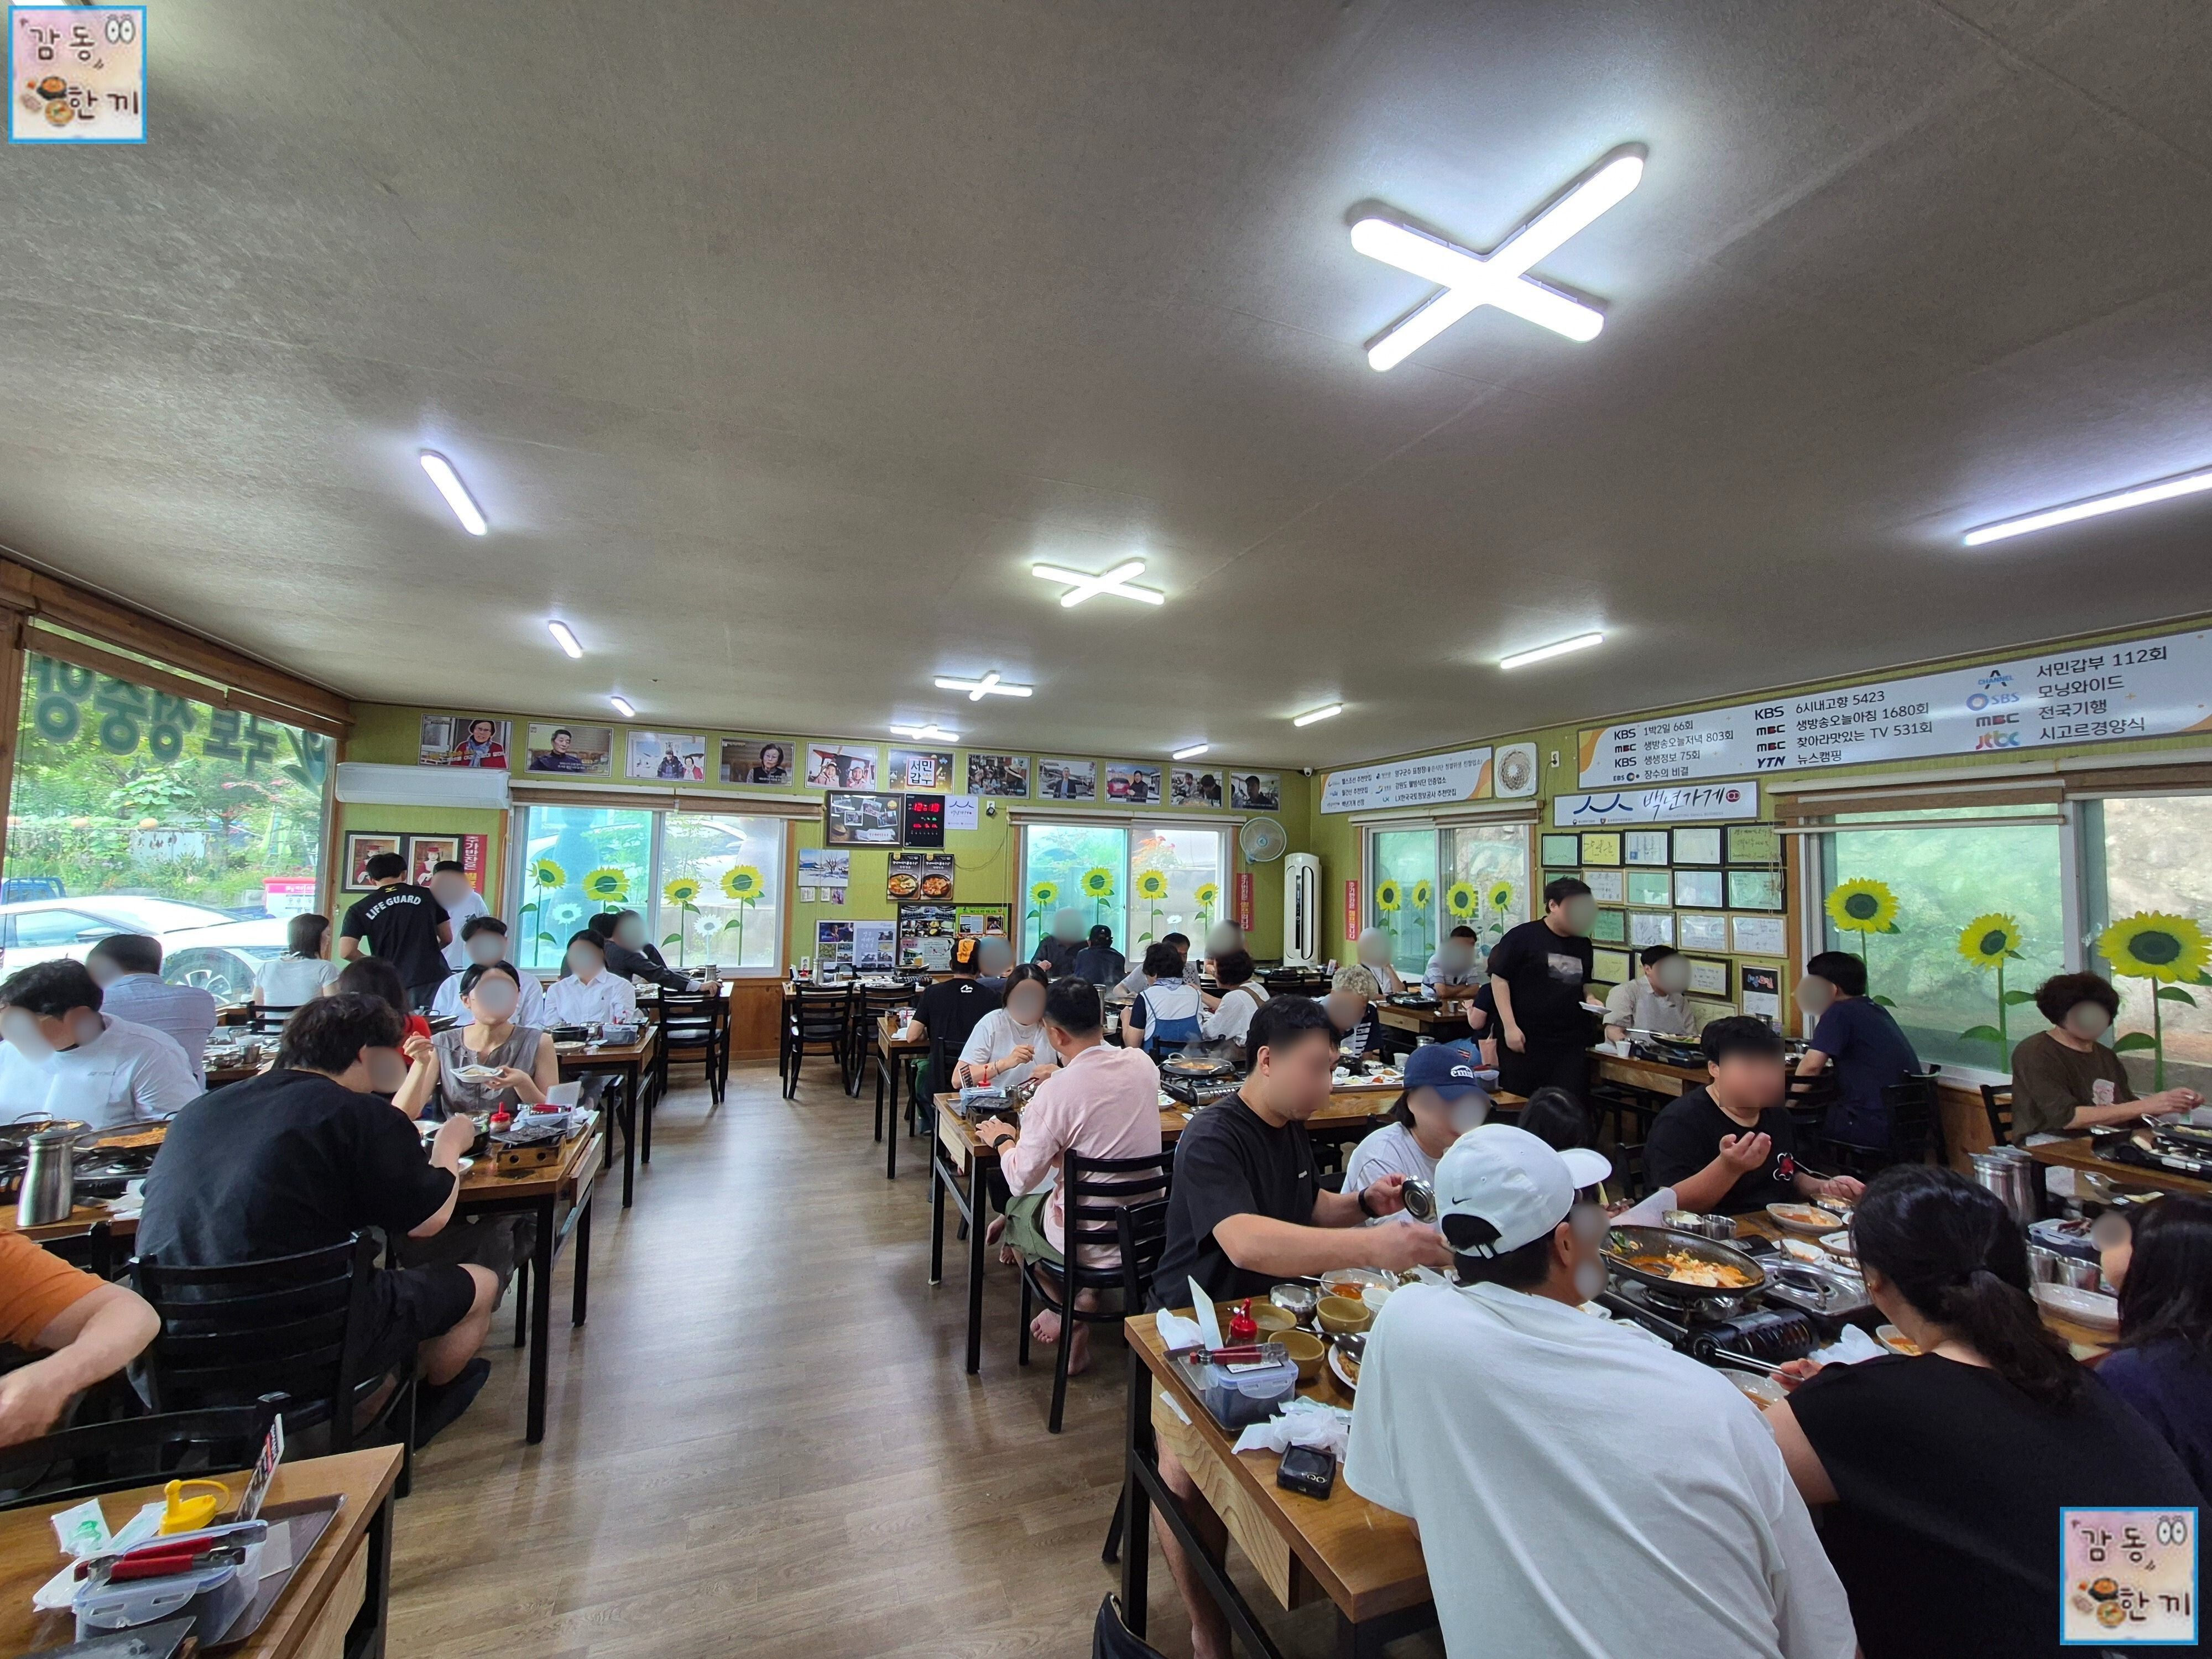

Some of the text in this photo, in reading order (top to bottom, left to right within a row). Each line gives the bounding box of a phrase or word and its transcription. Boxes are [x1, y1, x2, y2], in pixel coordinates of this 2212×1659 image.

[2037, 646, 2168, 678] 서민갑부 112회
[2038, 675, 2125, 699] 모닝와이드
[1796, 691, 1885, 714] 6시내고향 5423
[1991, 692, 2020, 705] SBS
[1755, 706, 1785, 720] KBS
[1796, 702, 1929, 731] 생방송오늘아침 1680회
[2038, 699, 2107, 720] 전국기행
[1614, 728, 1636, 740] KBS
[1644, 720, 1693, 735] 1박2일 66회
[1797, 721, 1933, 748] 찾아라맛있는 TV 531회
[2039, 717, 2146, 740] 시고르경양식
[1644, 730, 1734, 750] 생방송오늘저녁 803회
[1615, 757, 1637, 768] KBS
[1644, 750, 1700, 765] 생생정보 75회
[1757, 756, 1786, 769] YTN
[1797, 750, 1842, 765] 뉴스캠핑
[910, 760, 932, 772] 서민
[1644, 766, 1689, 780] 장수의 비결
[1644, 787, 1725, 821] 백년가게
